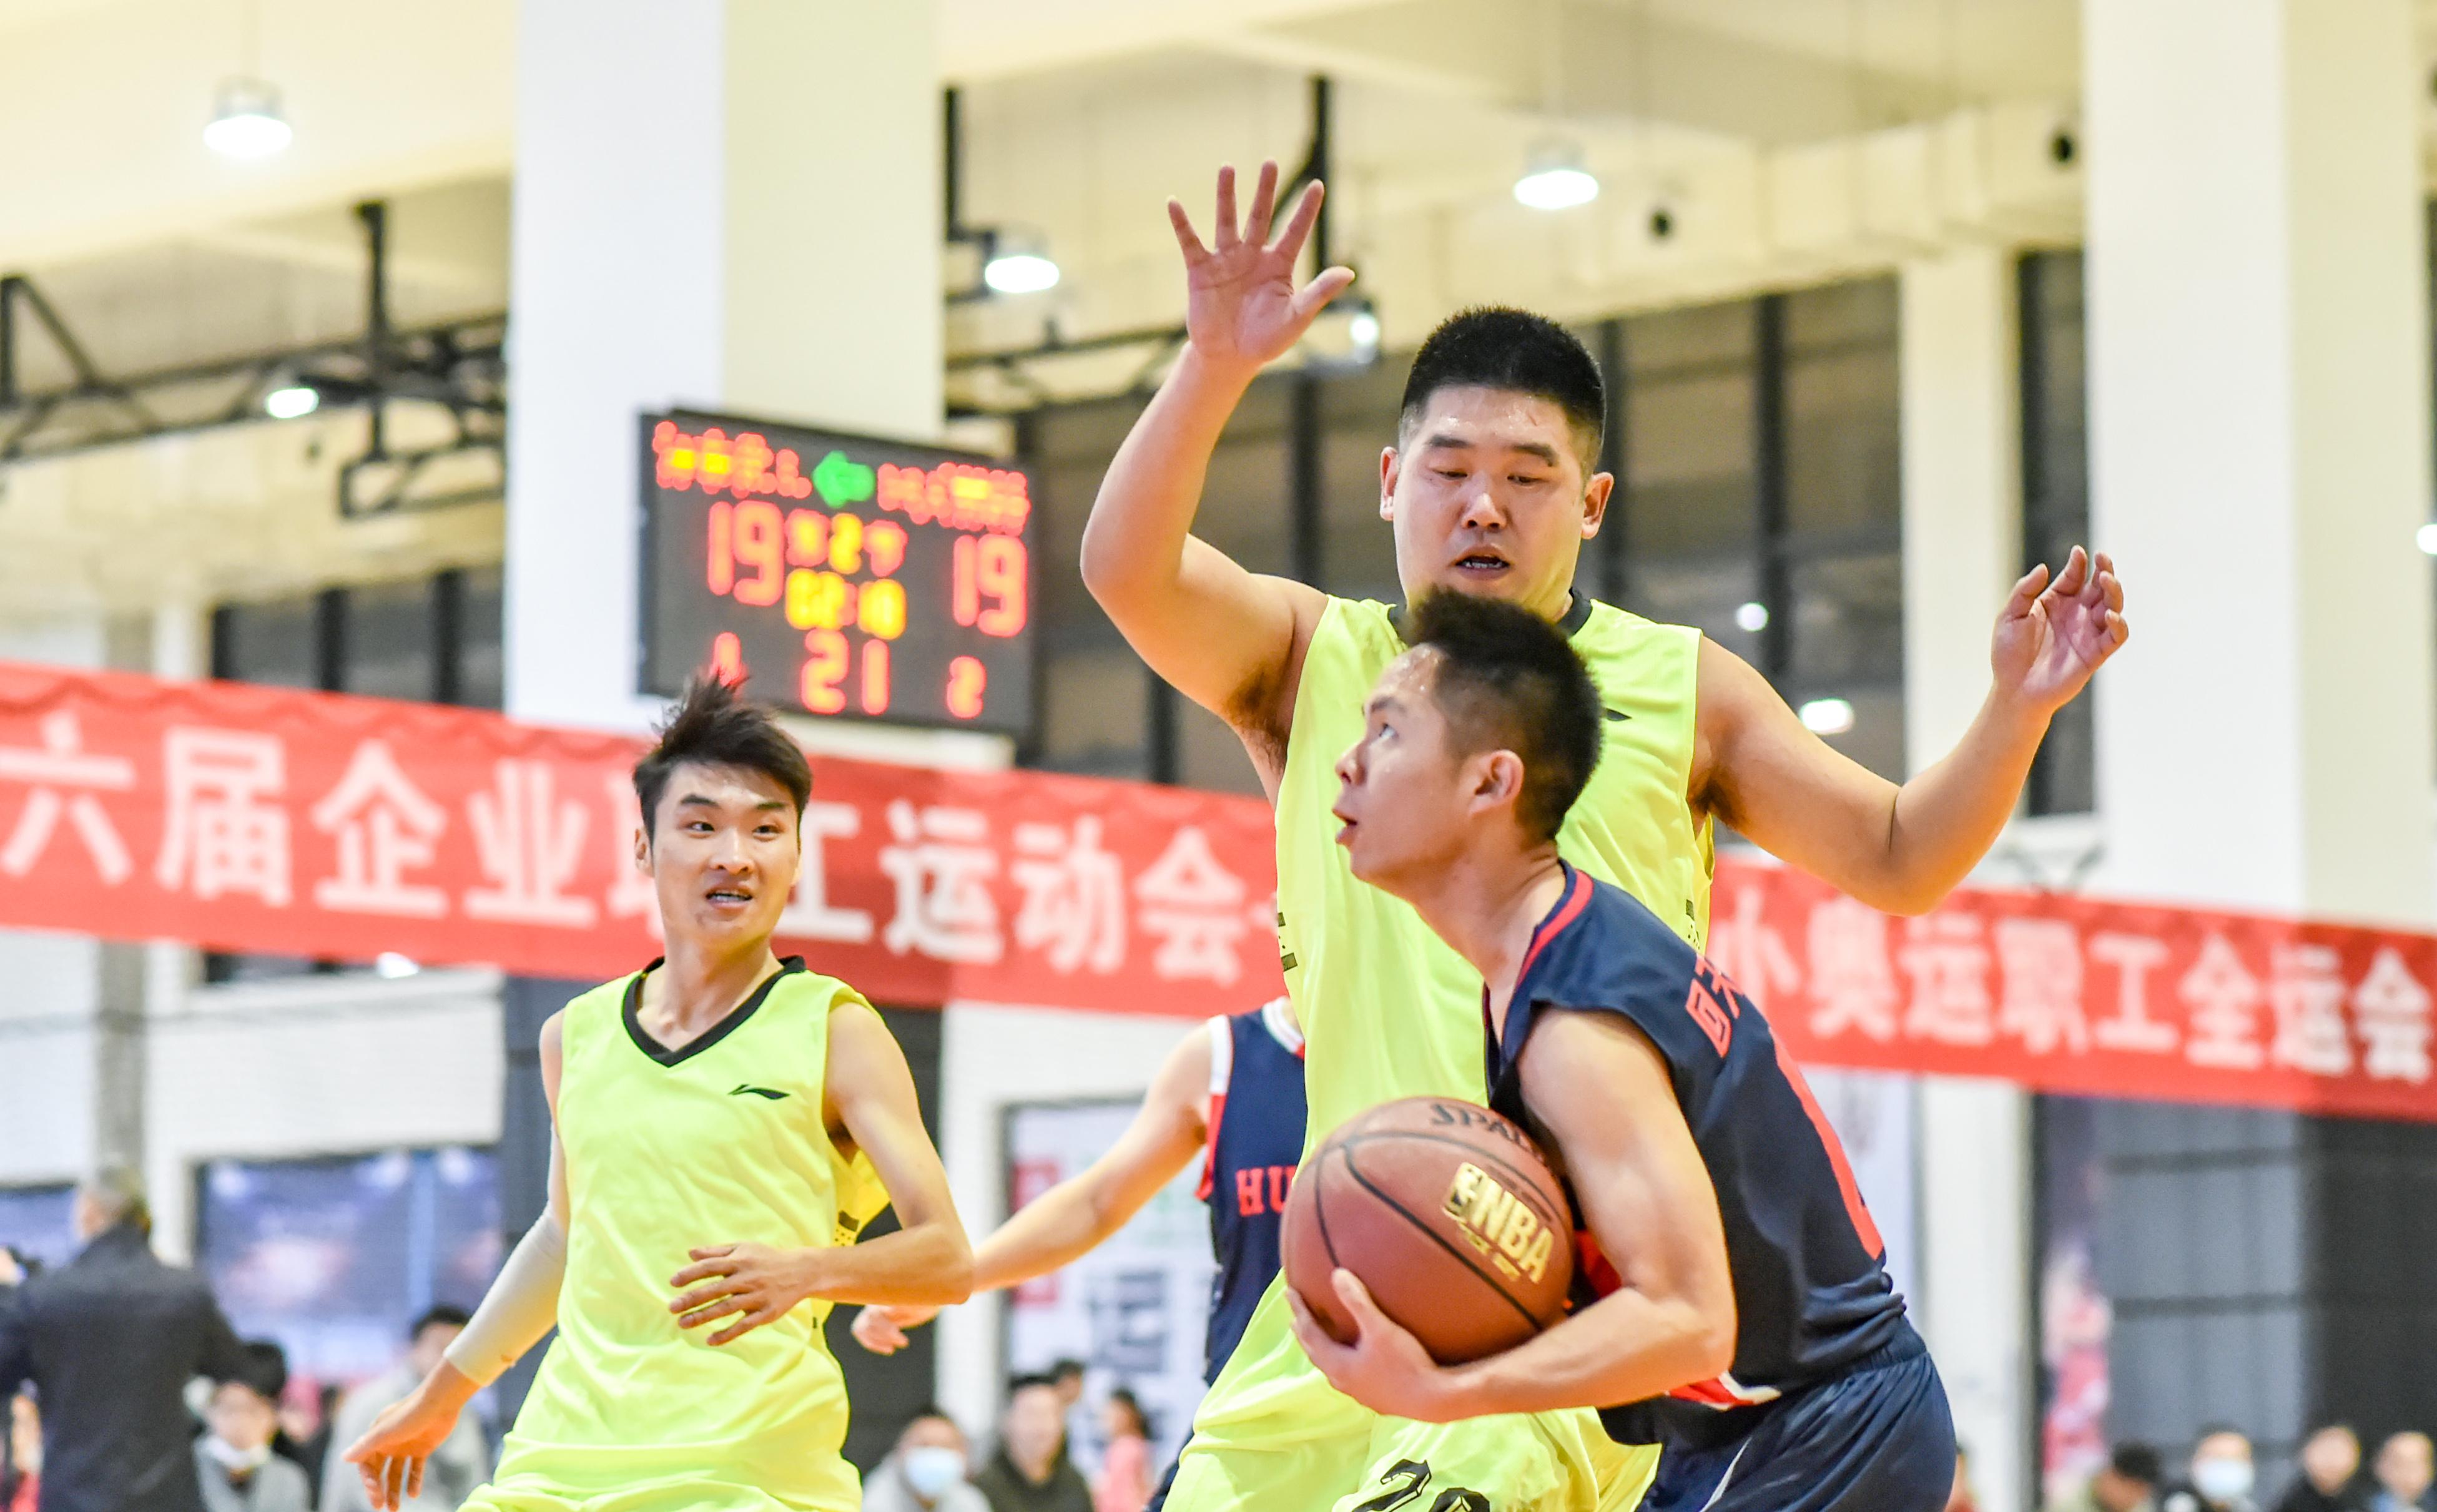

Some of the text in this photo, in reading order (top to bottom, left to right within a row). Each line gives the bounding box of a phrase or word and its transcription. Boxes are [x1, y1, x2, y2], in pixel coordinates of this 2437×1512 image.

[707, 501, 784, 606] 19
[953, 534, 1027, 638] 19
[802, 628, 890, 715] 21
[1472, 1177, 1555, 1284] NBA
